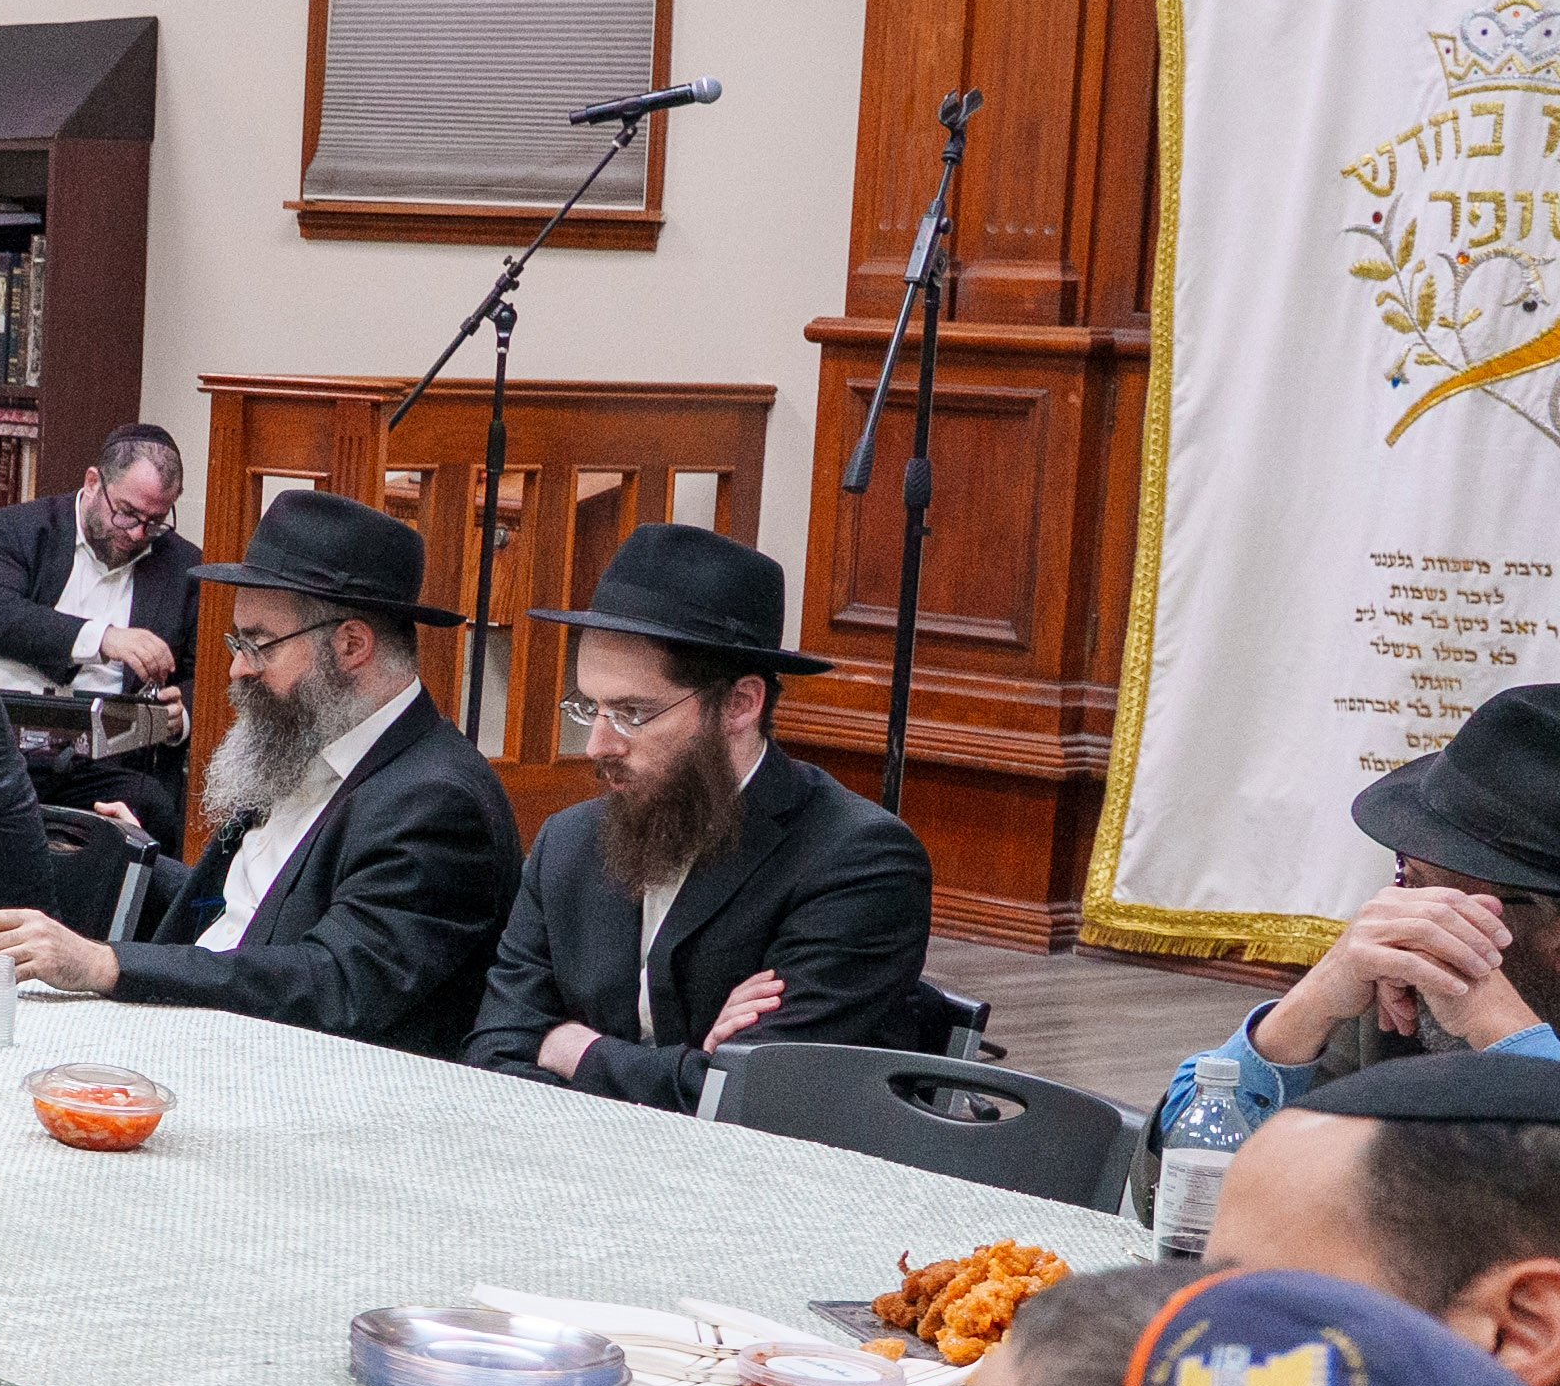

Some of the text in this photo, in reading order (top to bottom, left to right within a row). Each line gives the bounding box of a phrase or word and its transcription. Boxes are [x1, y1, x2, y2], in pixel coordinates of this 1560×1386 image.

[1340, 102, 1505, 198] בחדש
[1503, 560, 1554, 577] נדבת
[1389, 584, 1505, 606] לזכר נשמות
[1500, 618, 1538, 636] זאב
[1432, 640, 1478, 662] כסלו
